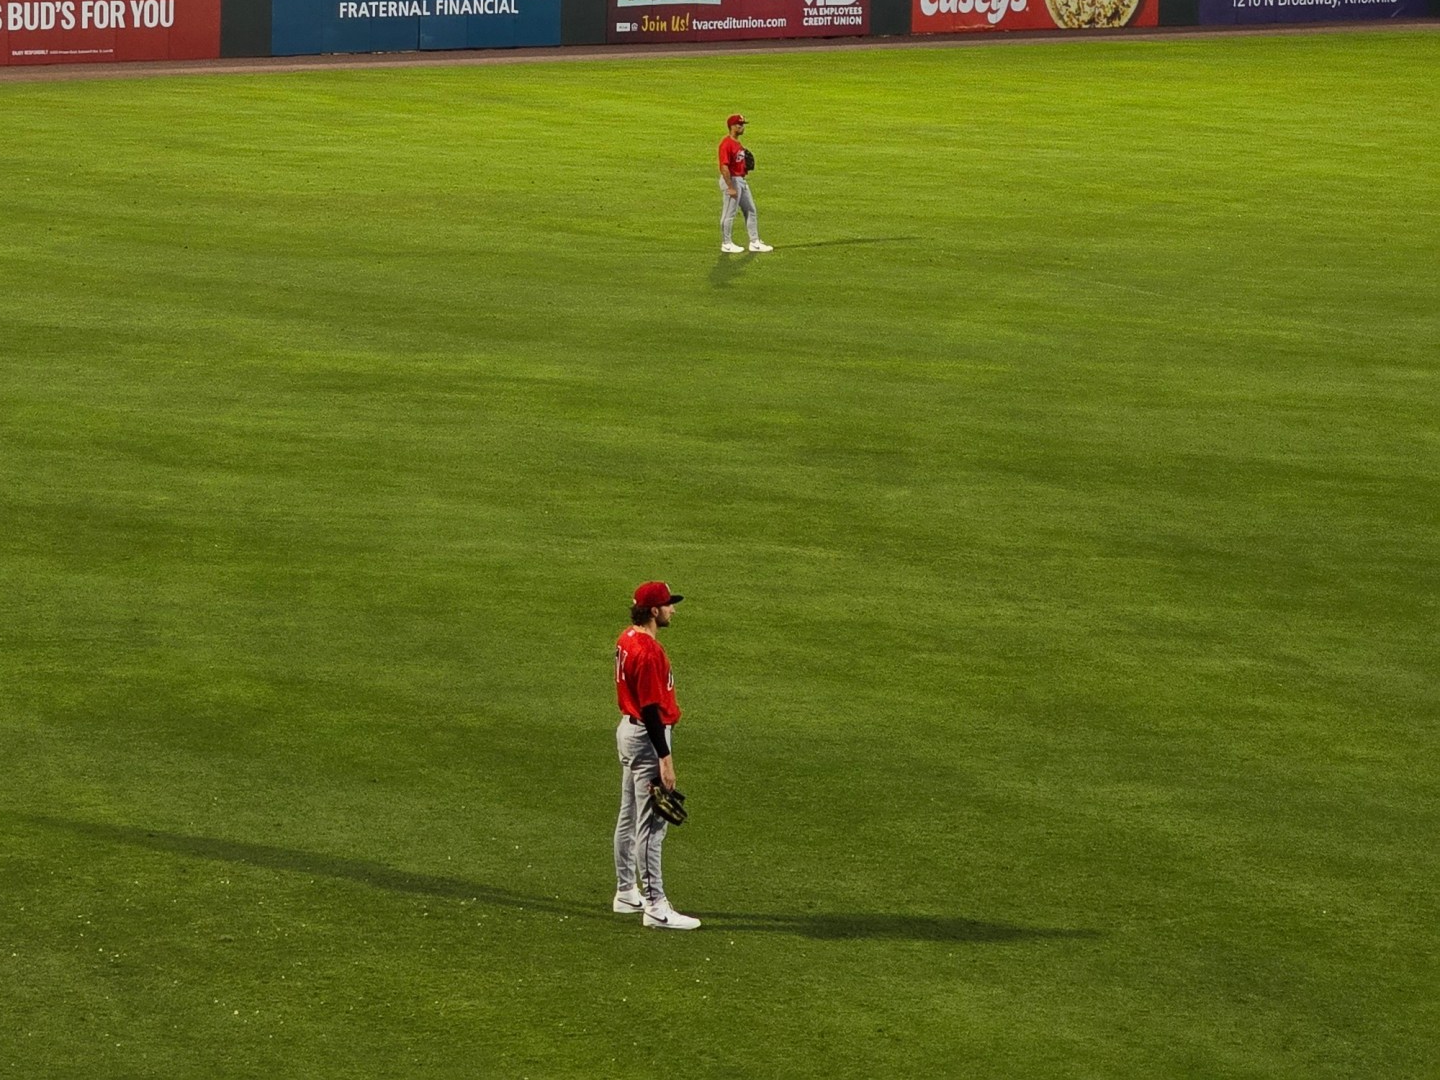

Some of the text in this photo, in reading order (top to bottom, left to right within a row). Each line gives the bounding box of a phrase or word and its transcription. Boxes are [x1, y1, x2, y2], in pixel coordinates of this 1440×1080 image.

[7, 1, 75, 31] BUD'S
[81, 0, 126, 29] FOR
[130, 0, 175, 28] YOU
[339, 0, 431, 19] FRATERNAL
[803, 6, 863, 16] TVA EMPLOYEES
[641, 14, 667, 32] Join
[671, 12, 690, 32] Us!
[692, 16, 787, 30] tvacreditunion.com
[803, 16, 862, 26] CREDIT UNION
